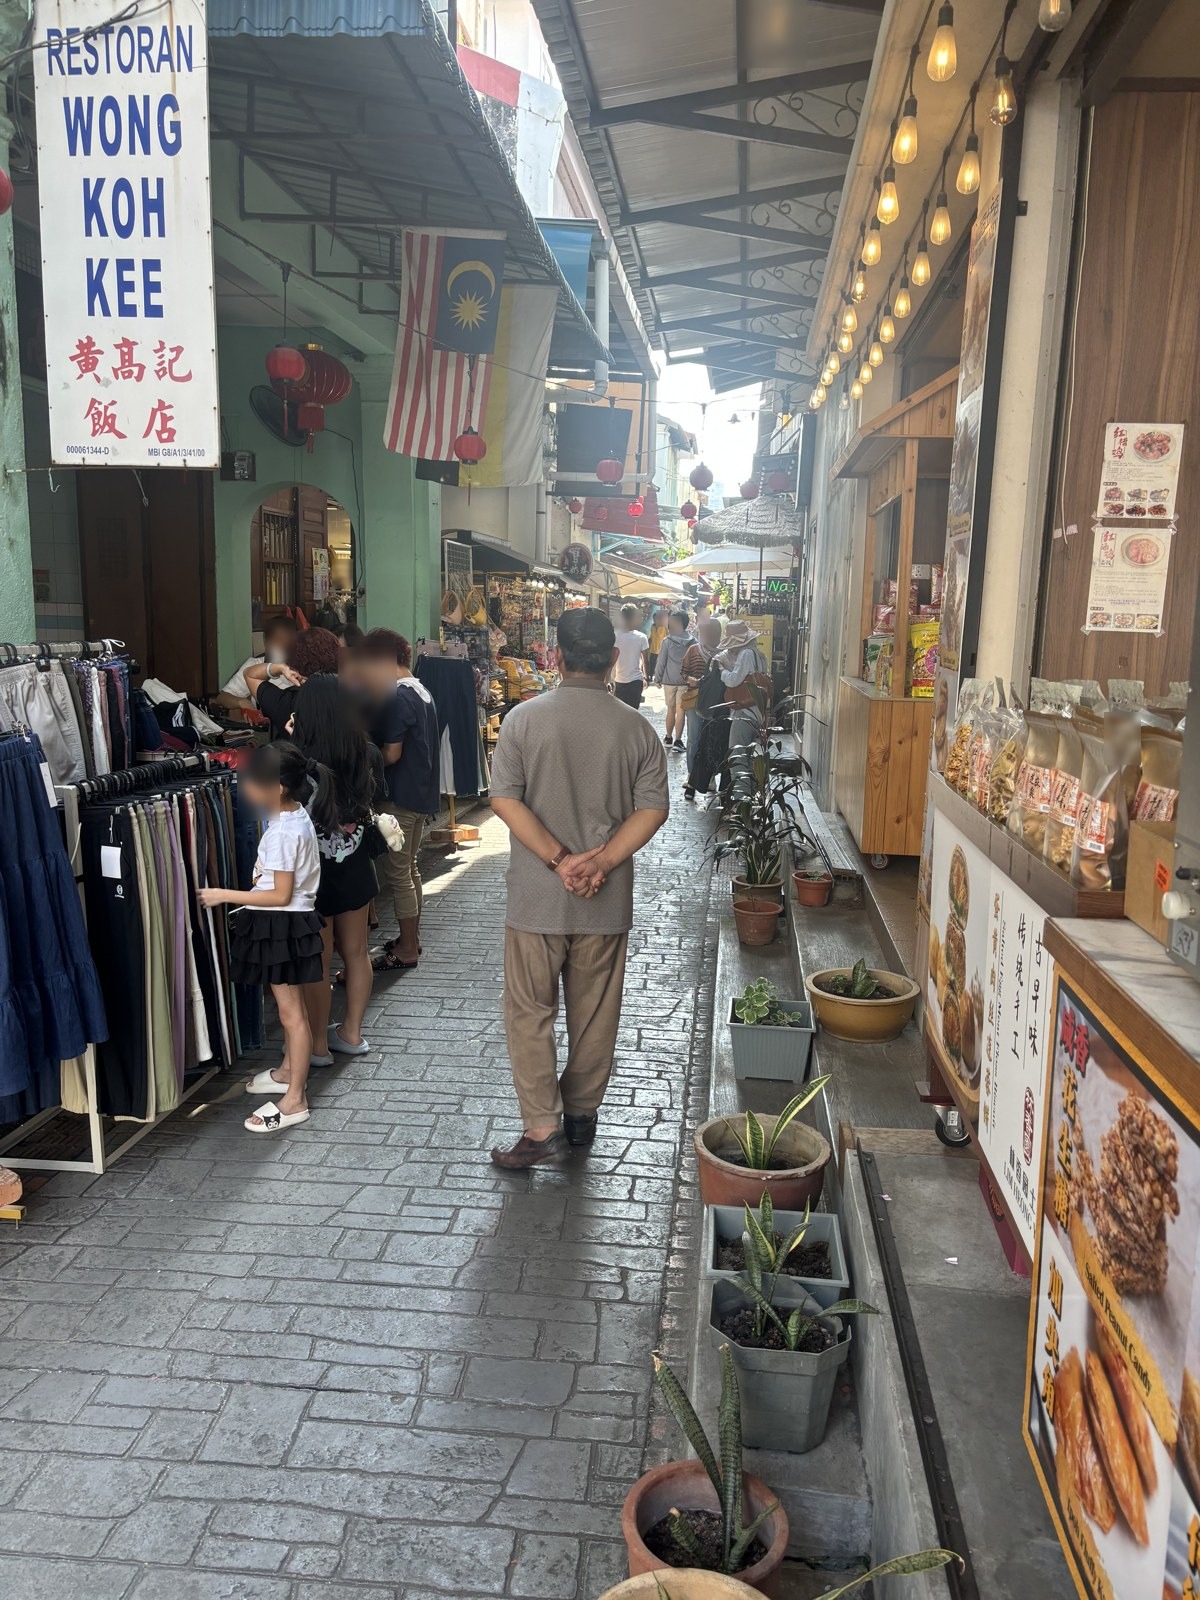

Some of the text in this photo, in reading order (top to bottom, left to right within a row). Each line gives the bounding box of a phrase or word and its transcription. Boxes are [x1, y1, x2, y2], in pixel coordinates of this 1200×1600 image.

[47, 25, 193, 76] RESTORAN
[63, 93, 183, 157] WONG
[82, 177, 166, 239] KOH
[85, 258, 164, 319] KEE
[66, 445, 110, 455] 000061344-D
[84, 397, 177, 444] 飯店
[1011, 913, 1026, 1060] 传统手工
[1029, 932, 1043, 1058] 古早味
[1054, 1063, 1077, 1234] 花生糖
[1042, 1255, 1063, 1425] 加央角
[1085, 1262, 1152, 1397] Salted Peanut Candy
